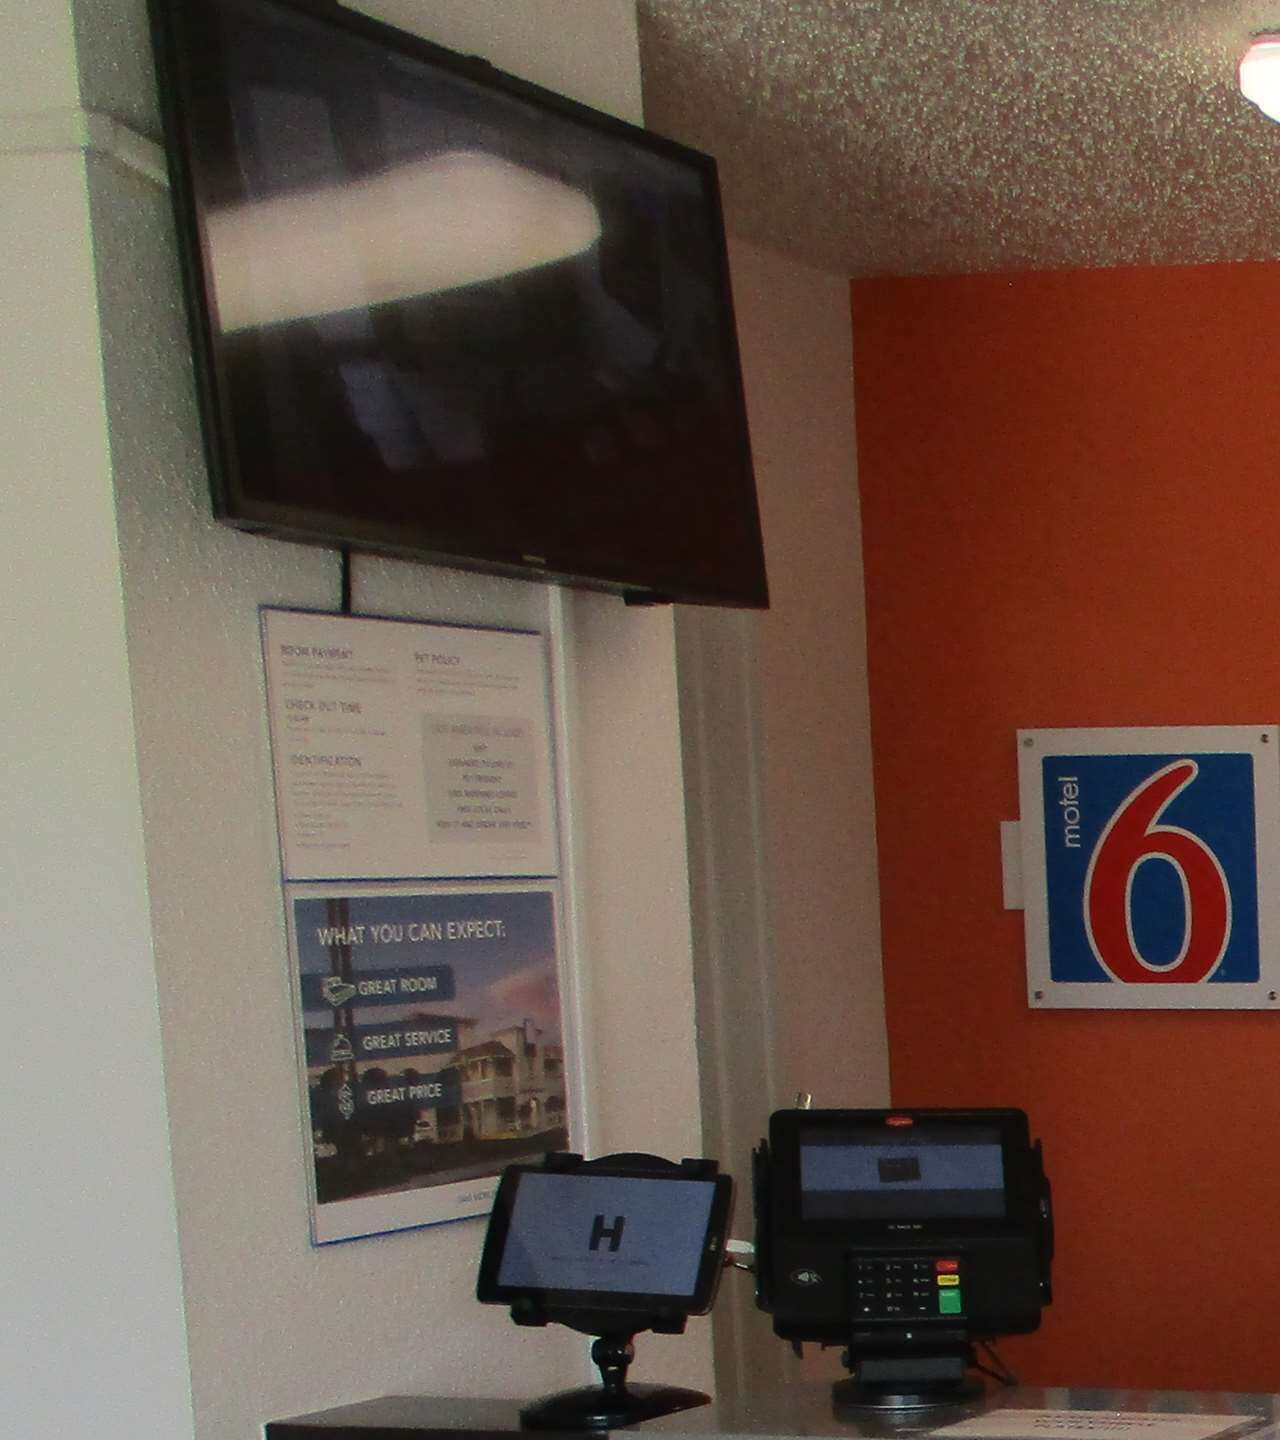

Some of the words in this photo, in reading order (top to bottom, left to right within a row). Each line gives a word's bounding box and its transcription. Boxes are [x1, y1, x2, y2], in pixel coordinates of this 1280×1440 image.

[1057, 775, 1082, 849] motel
[1083, 758, 1232, 983] 6
[316, 925, 366, 946] WHAT
[370, 923, 404, 944] YOU
[408, 922, 442, 943] CAN
[447, 919, 507, 940] EXPECT:
[358, 978, 398, 997] GREAT
[400, 976, 438, 993] ROOM
[362, 1032, 402, 1051] GREAT
[404, 1028, 453, 1047] SERVICE
[367, 1087, 407, 1106] GREAT
[408, 1083, 443, 1100] PRICE
[588, 1213, 626, 1252] H
